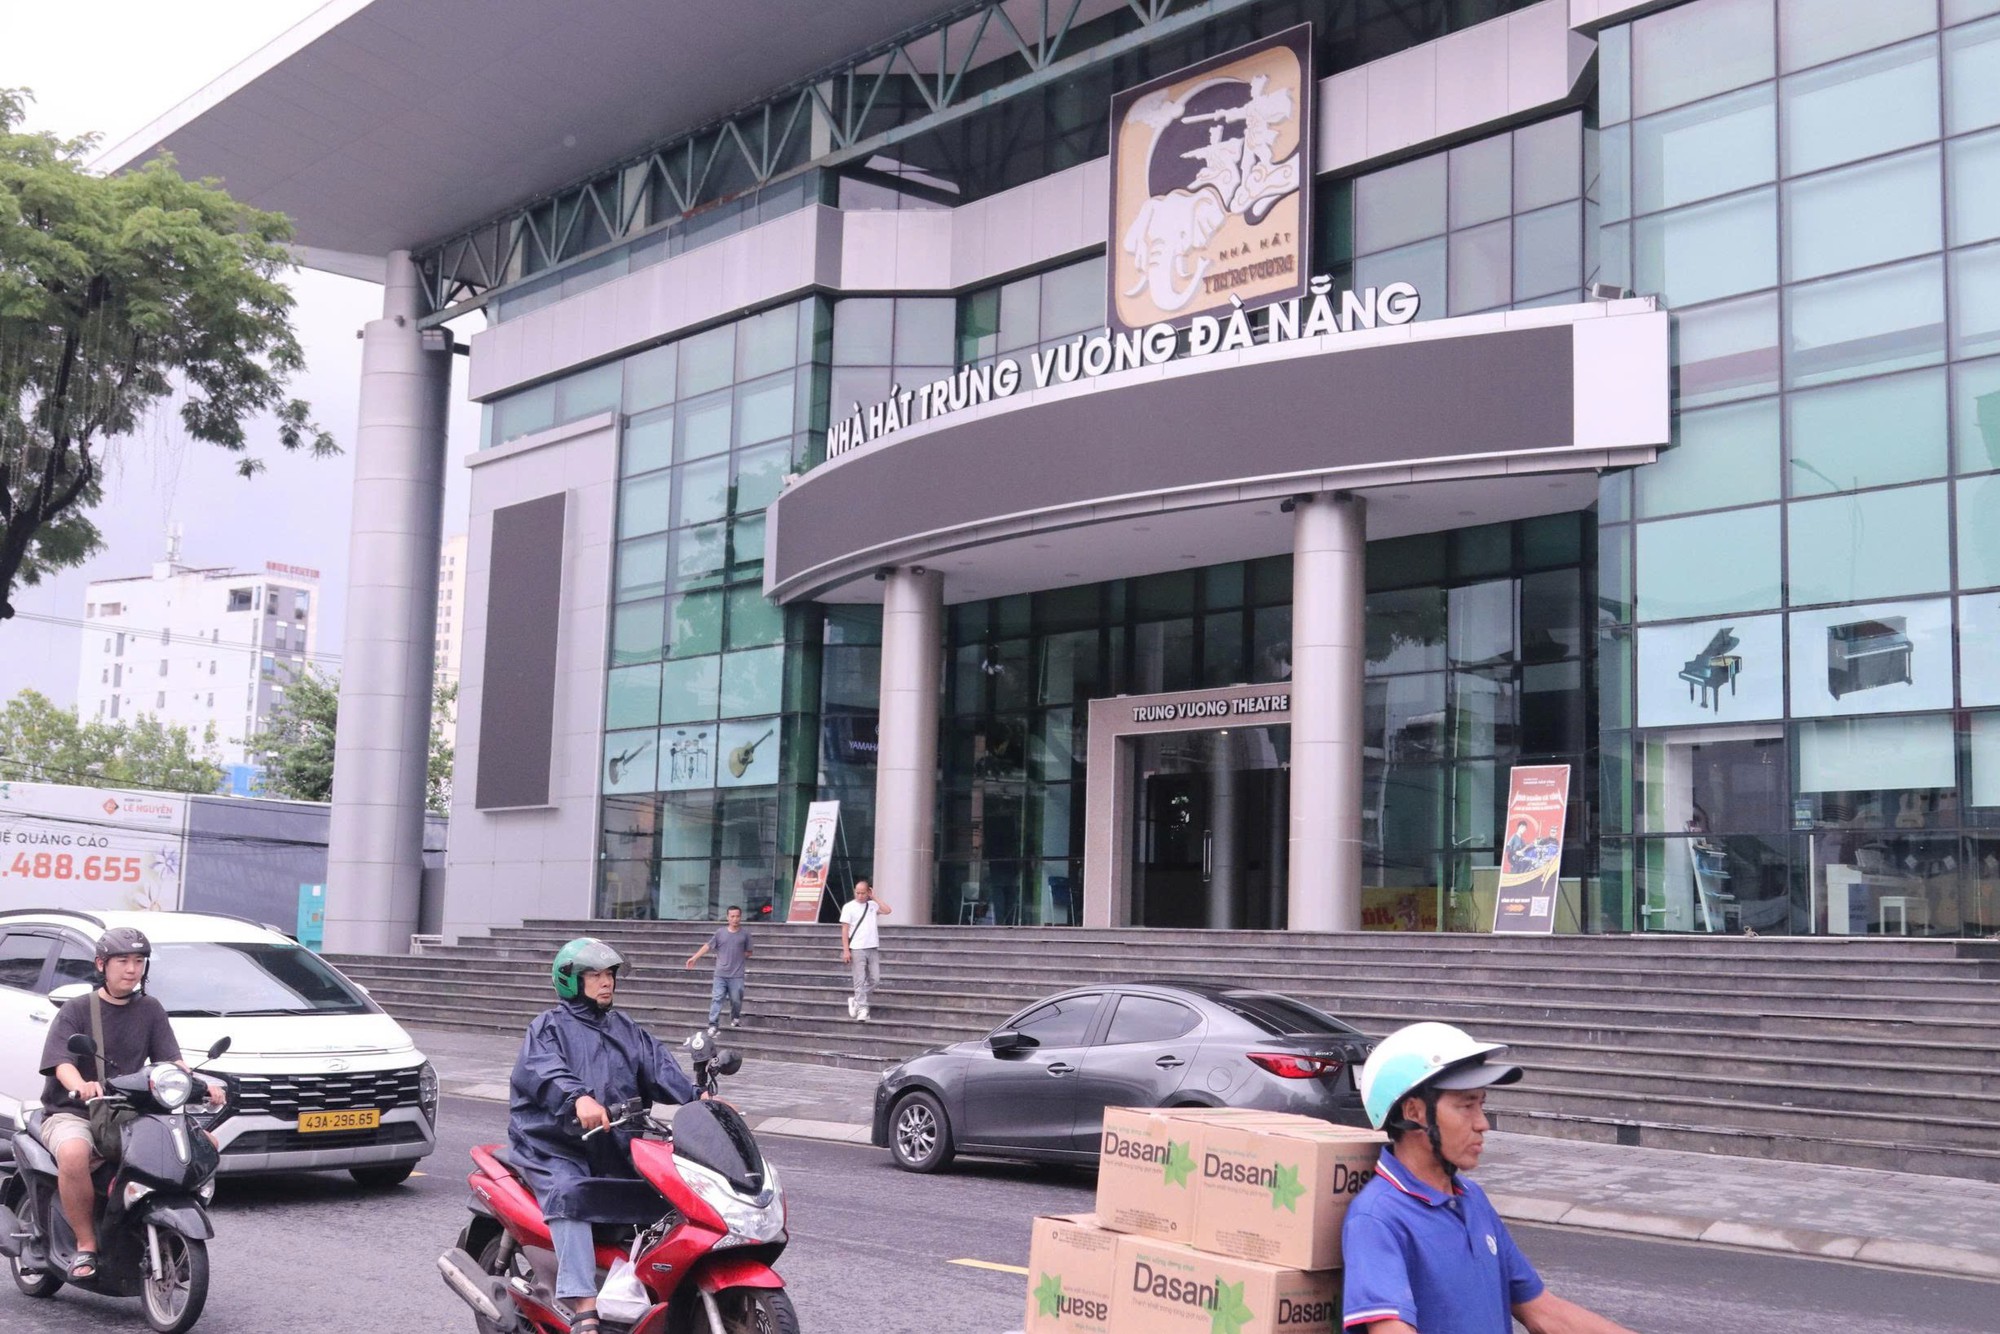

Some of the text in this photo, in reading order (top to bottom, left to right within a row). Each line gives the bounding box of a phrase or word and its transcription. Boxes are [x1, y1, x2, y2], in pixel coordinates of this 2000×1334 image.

[826, 273, 1422, 461] NHÀ HÁT TRƯNG VƯƠNG ĐÀ NẴNG
[1132, 694, 1290, 722] TRUNG VUONG THEATRE
[16, 830, 72, 846] QUẢNG
[76, 832, 109, 848] CÁO
[1104, 1131, 1172, 1166] Dasani
[1203, 1152, 1279, 1189] Dasani
[1332, 1163, 1377, 1195] Das
[1133, 1261, 1220, 1311] Dasani
[1055, 1294, 1108, 1321] asani
